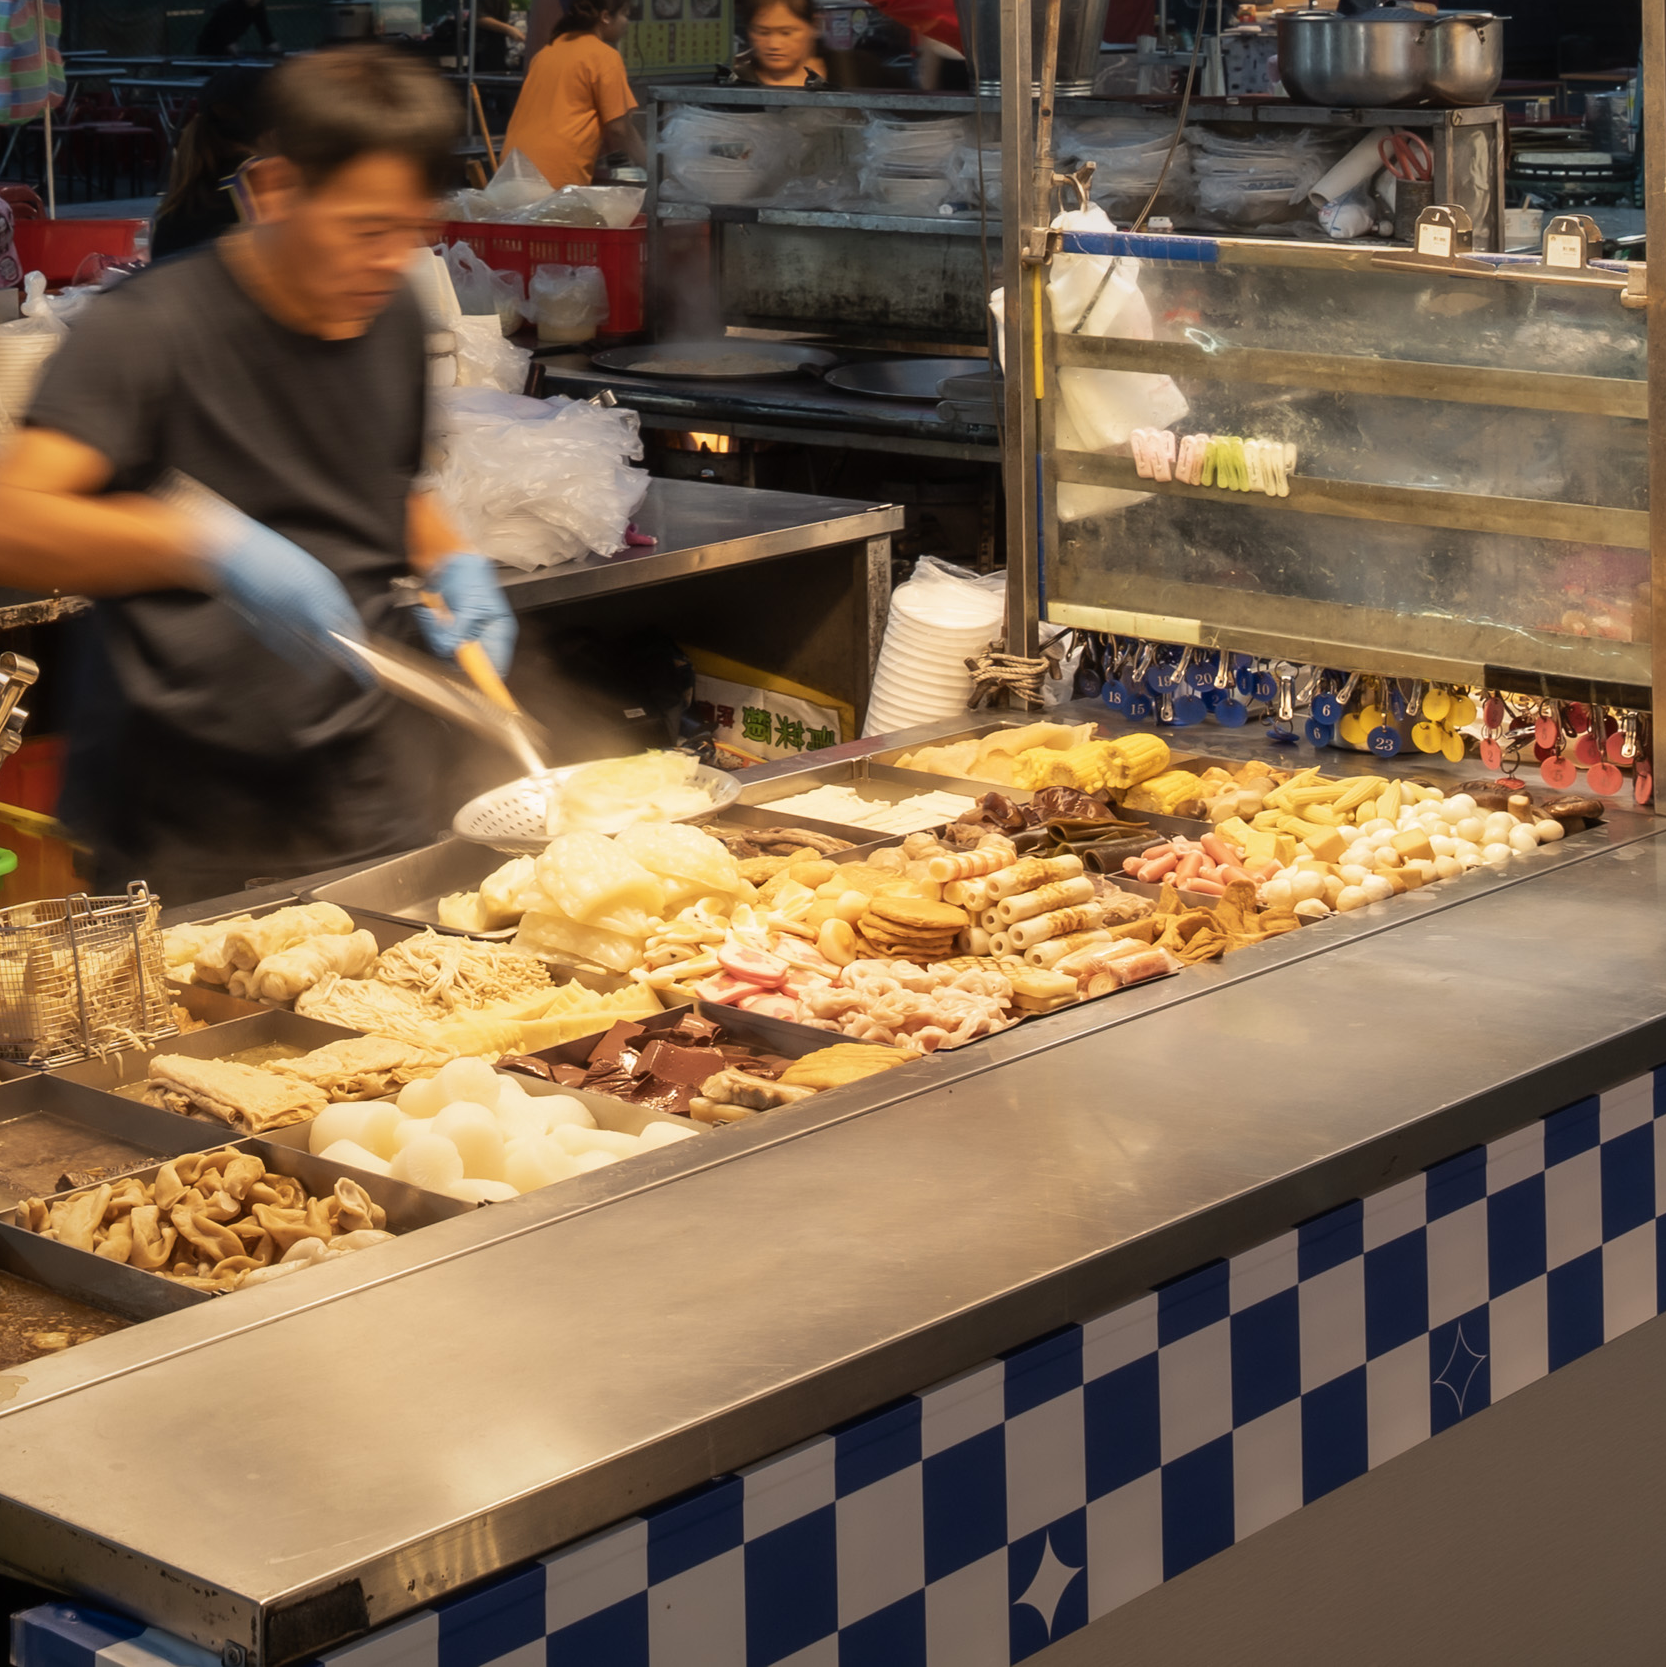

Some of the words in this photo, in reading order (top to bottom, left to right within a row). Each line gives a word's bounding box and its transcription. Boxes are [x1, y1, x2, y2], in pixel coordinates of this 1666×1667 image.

[1195, 672, 1213, 686] 20
[1255, 683, 1270, 696] 10
[1108, 691, 1121, 704] 18
[1130, 703, 1145, 715] 15
[1322, 704, 1331, 717] 6
[1375, 736, 1395, 752] 23
